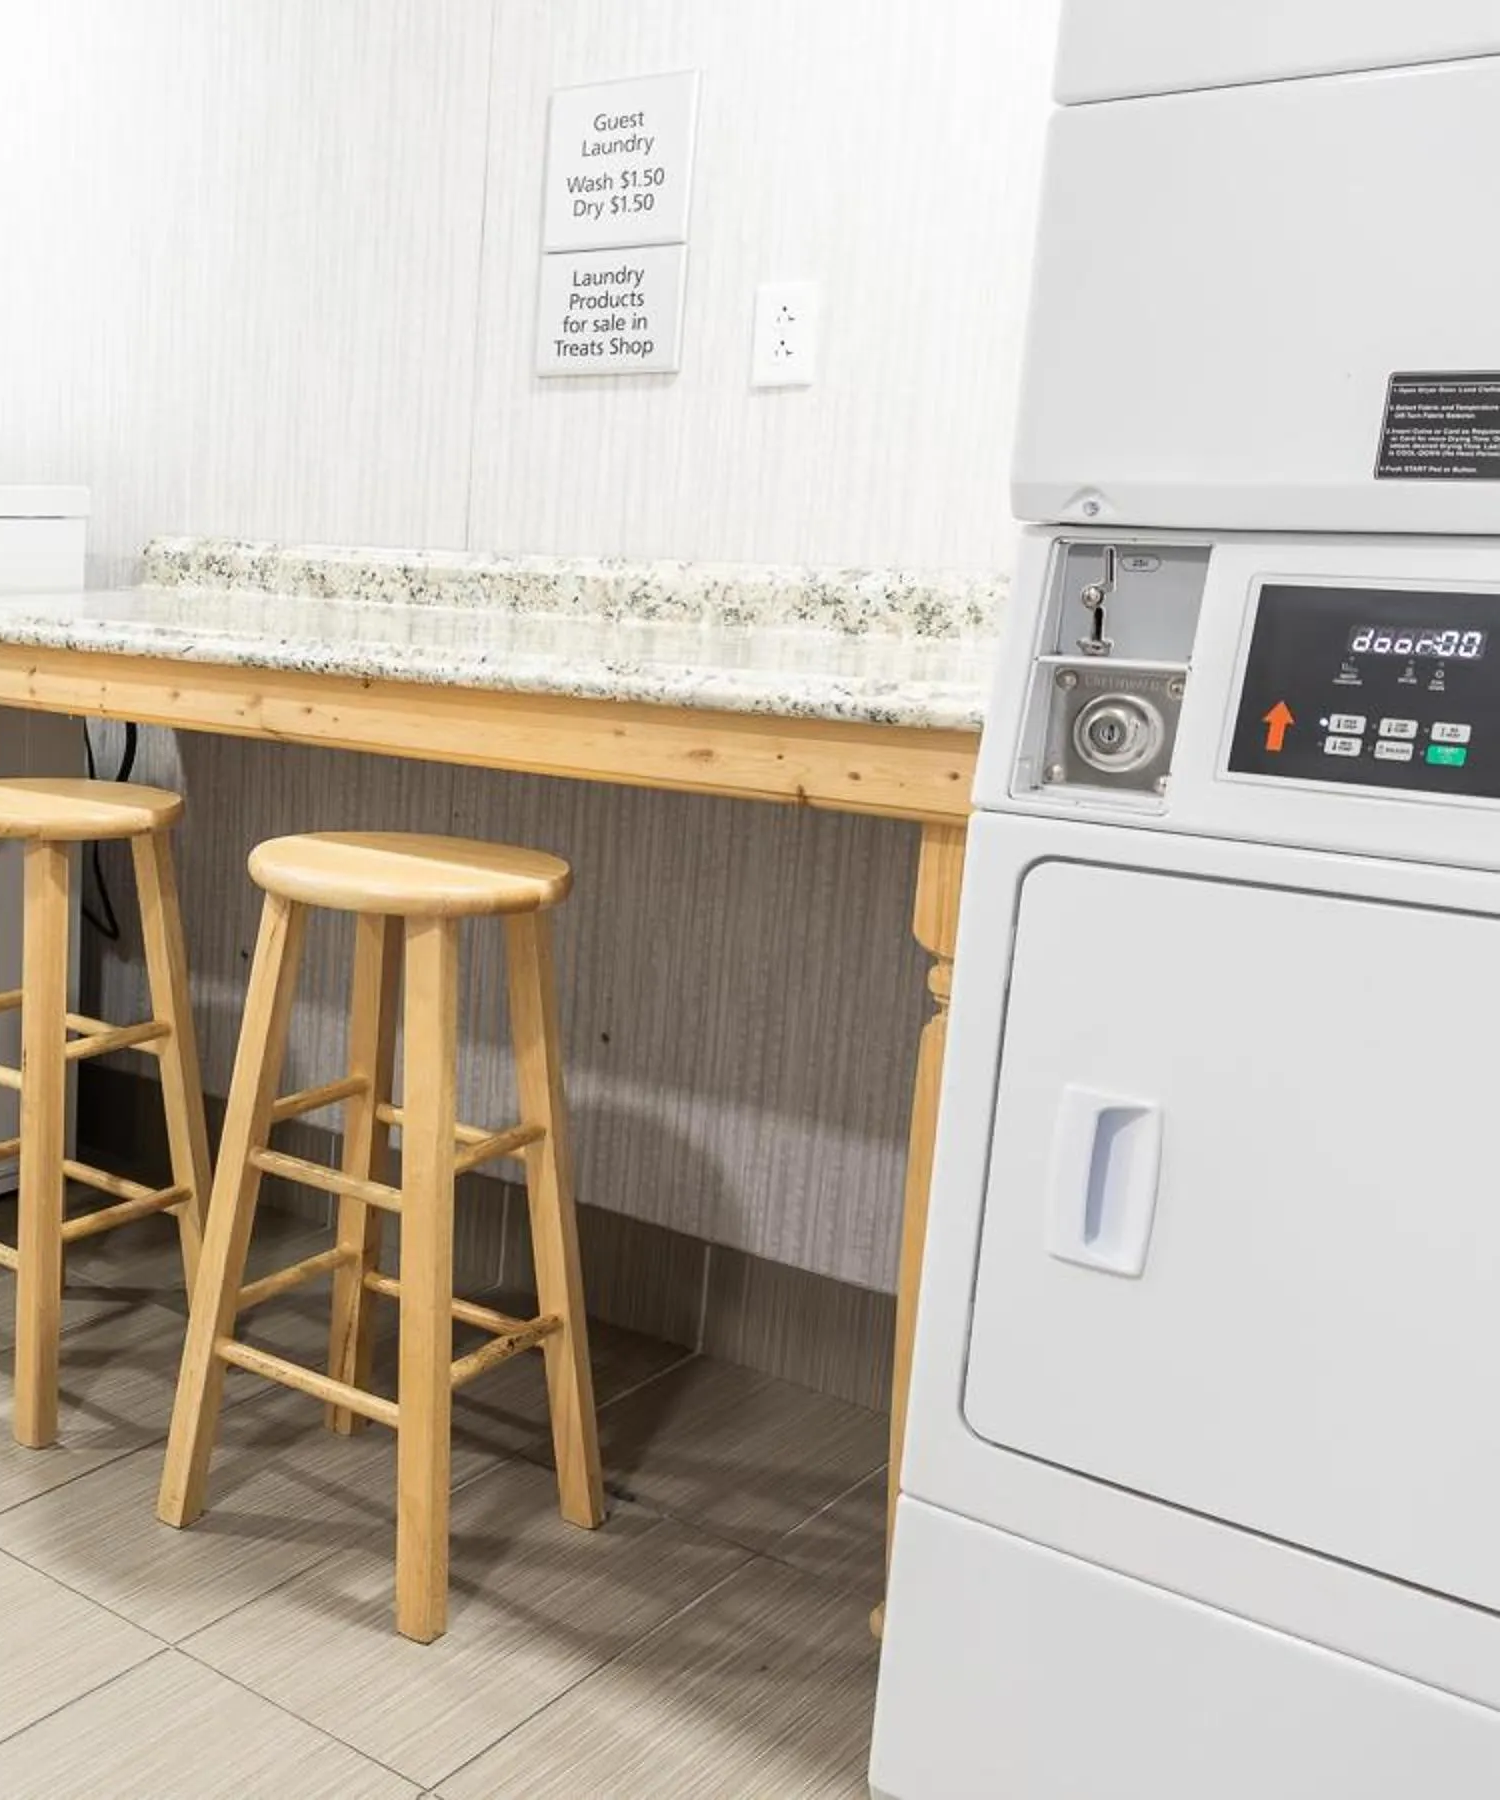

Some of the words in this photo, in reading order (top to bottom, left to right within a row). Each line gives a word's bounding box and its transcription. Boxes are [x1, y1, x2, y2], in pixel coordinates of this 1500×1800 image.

[593, 111, 645, 132] Guest
[581, 133, 655, 158] Laundry
[566, 172, 614, 194] Wash
[620, 167, 665, 190] $1.50
[573, 199, 605, 221] Dry
[610, 192, 655, 215] $1.50
[572, 265, 645, 289] Laundry
[568, 289, 645, 311] Products
[562, 315, 589, 334] for
[592, 313, 627, 333] sale
[631, 312, 648, 331] in
[553, 339, 605, 358] Treats
[609, 336, 655, 359] Shop
